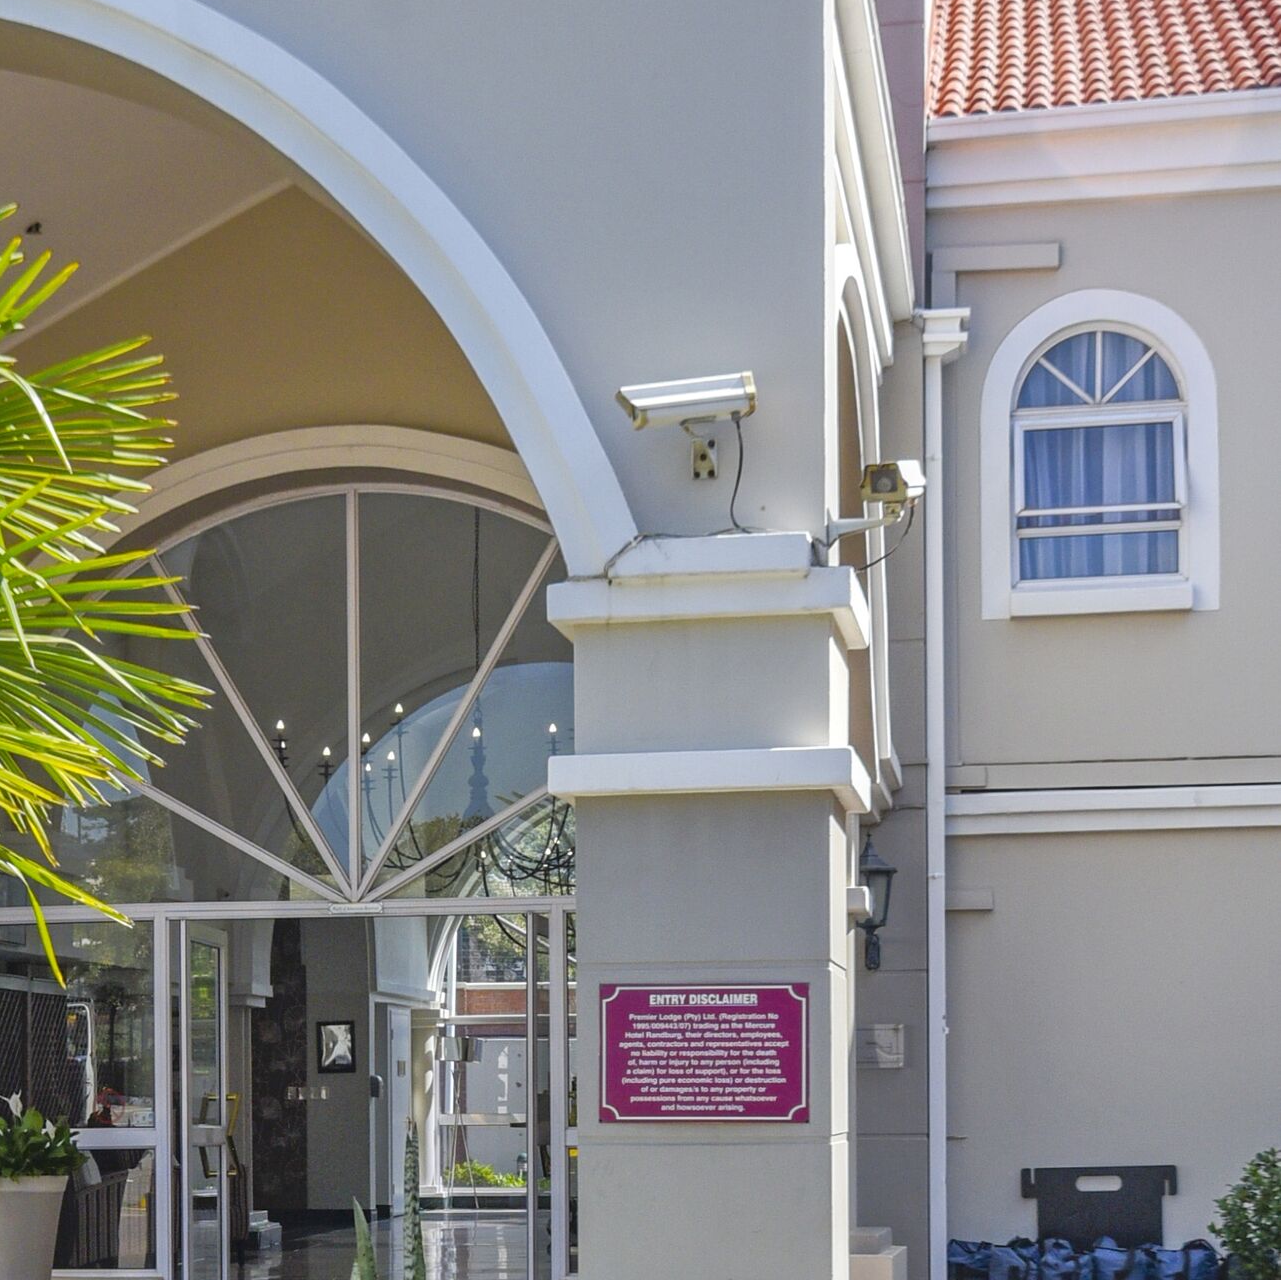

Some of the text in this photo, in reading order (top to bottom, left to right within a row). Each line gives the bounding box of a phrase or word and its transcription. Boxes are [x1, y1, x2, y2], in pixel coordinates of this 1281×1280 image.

[649, 994, 758, 1005] ENTRY DISCLAIMER
[725, 1086, 757, 1094] property
